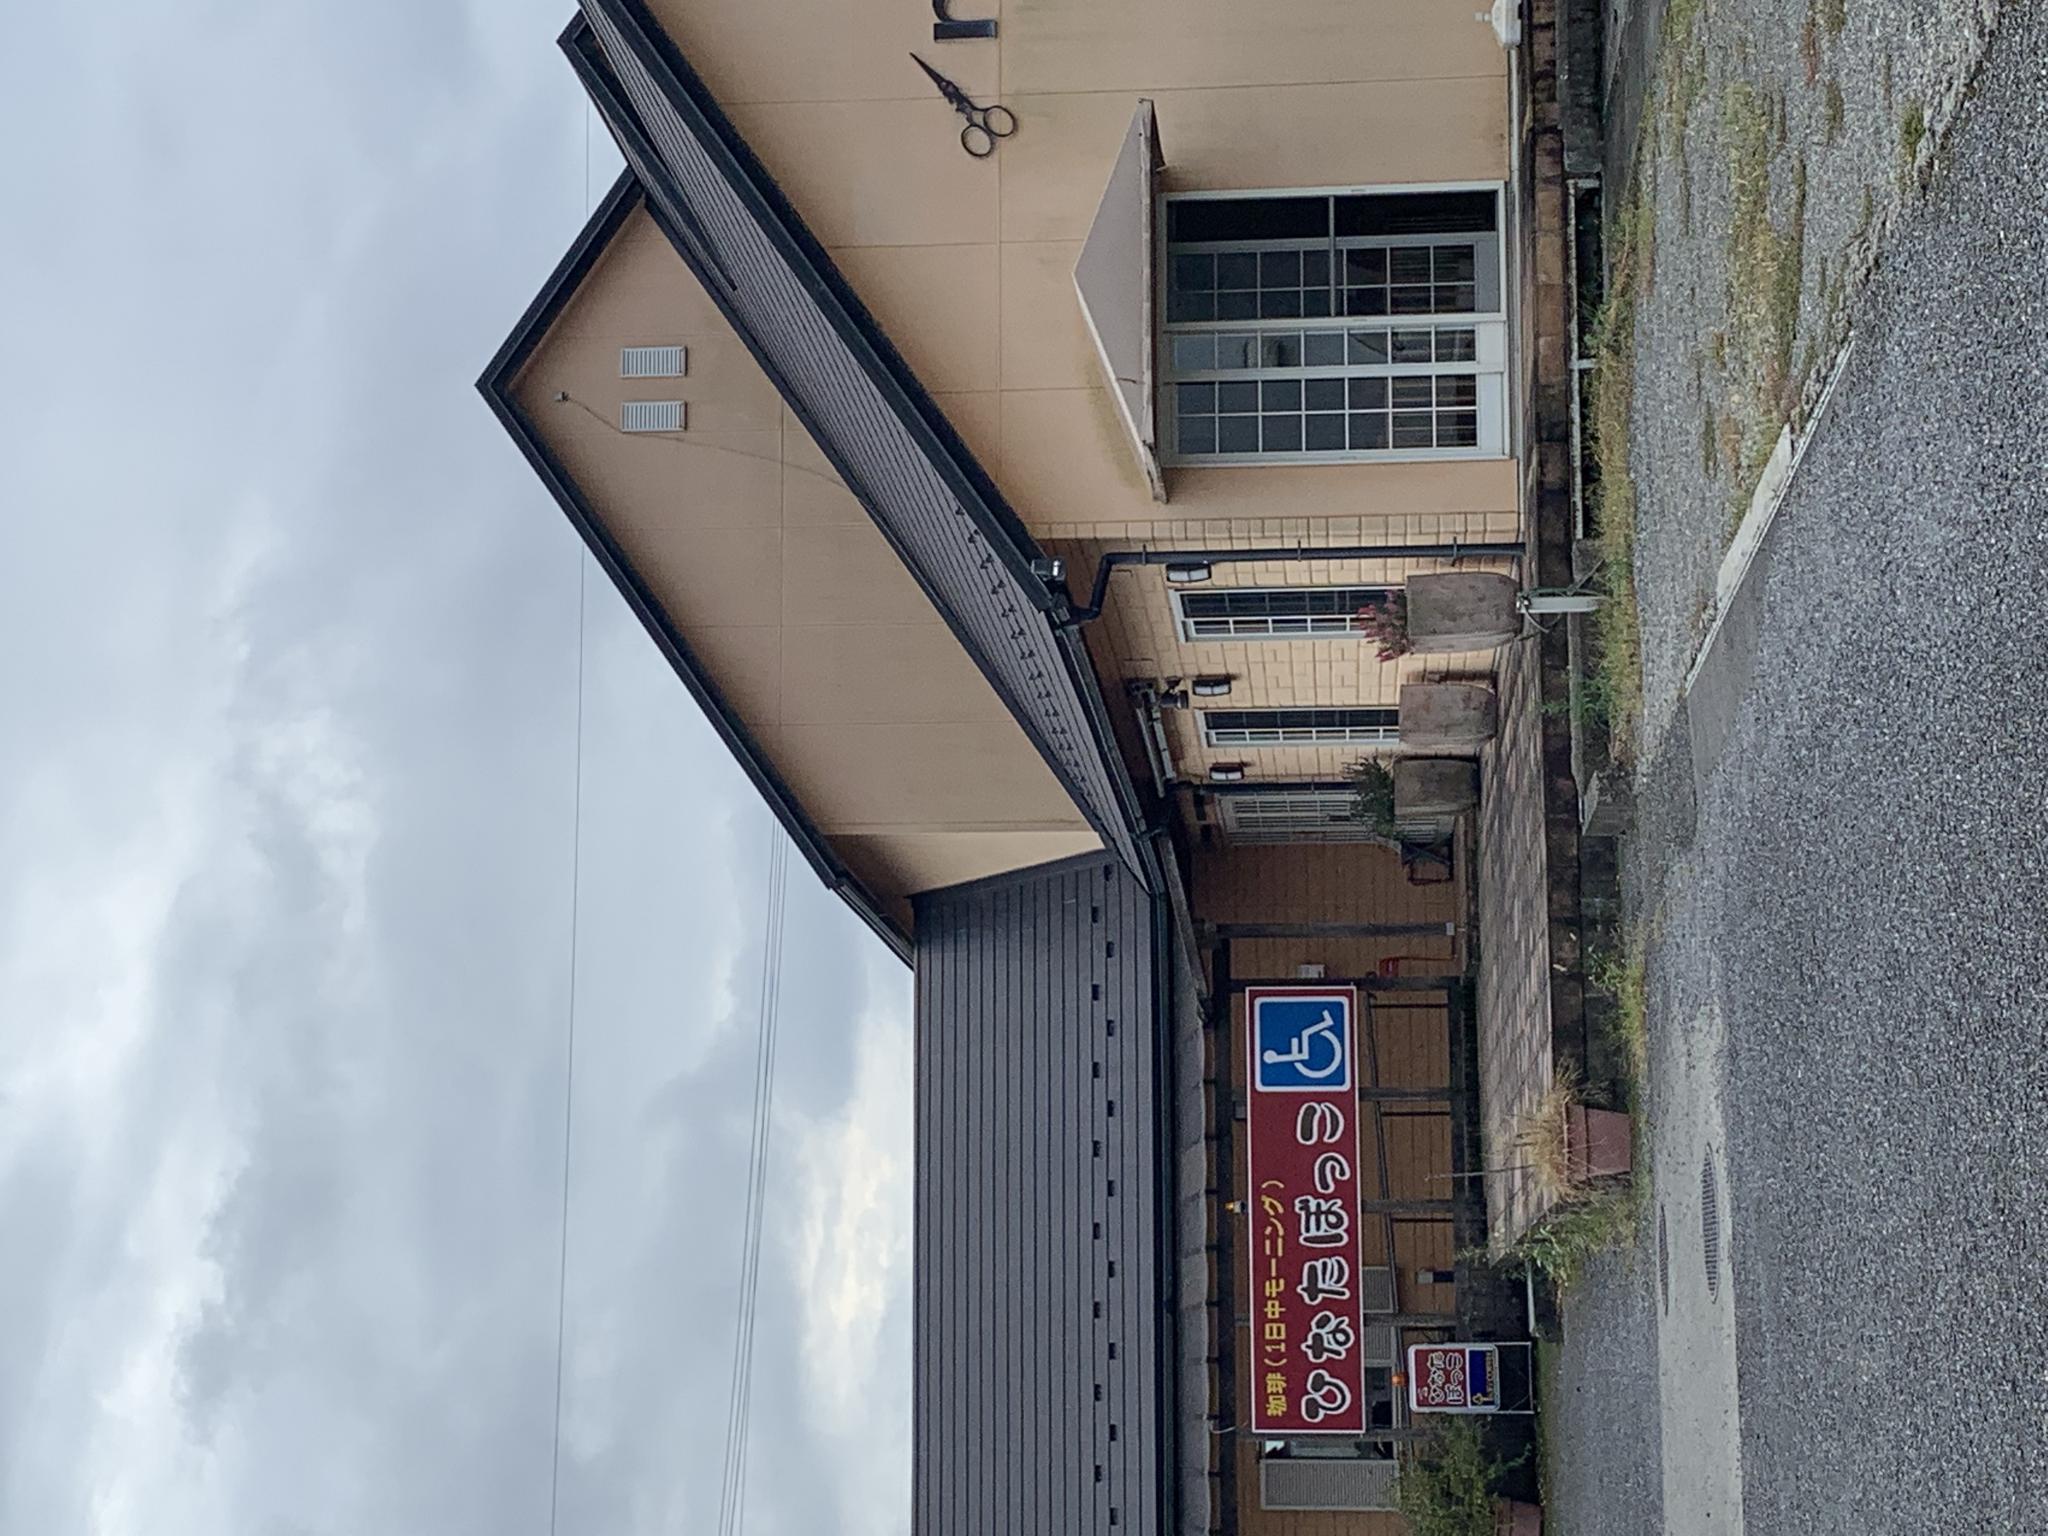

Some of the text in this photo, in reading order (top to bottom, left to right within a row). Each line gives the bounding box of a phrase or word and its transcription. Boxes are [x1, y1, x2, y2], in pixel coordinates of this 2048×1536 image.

[1293, 1101, 1355, 1423] ひなたぼっこ
[1426, 1351, 1446, 1405] ひなた
[1444, 1352, 1464, 1405] ぼっこ
